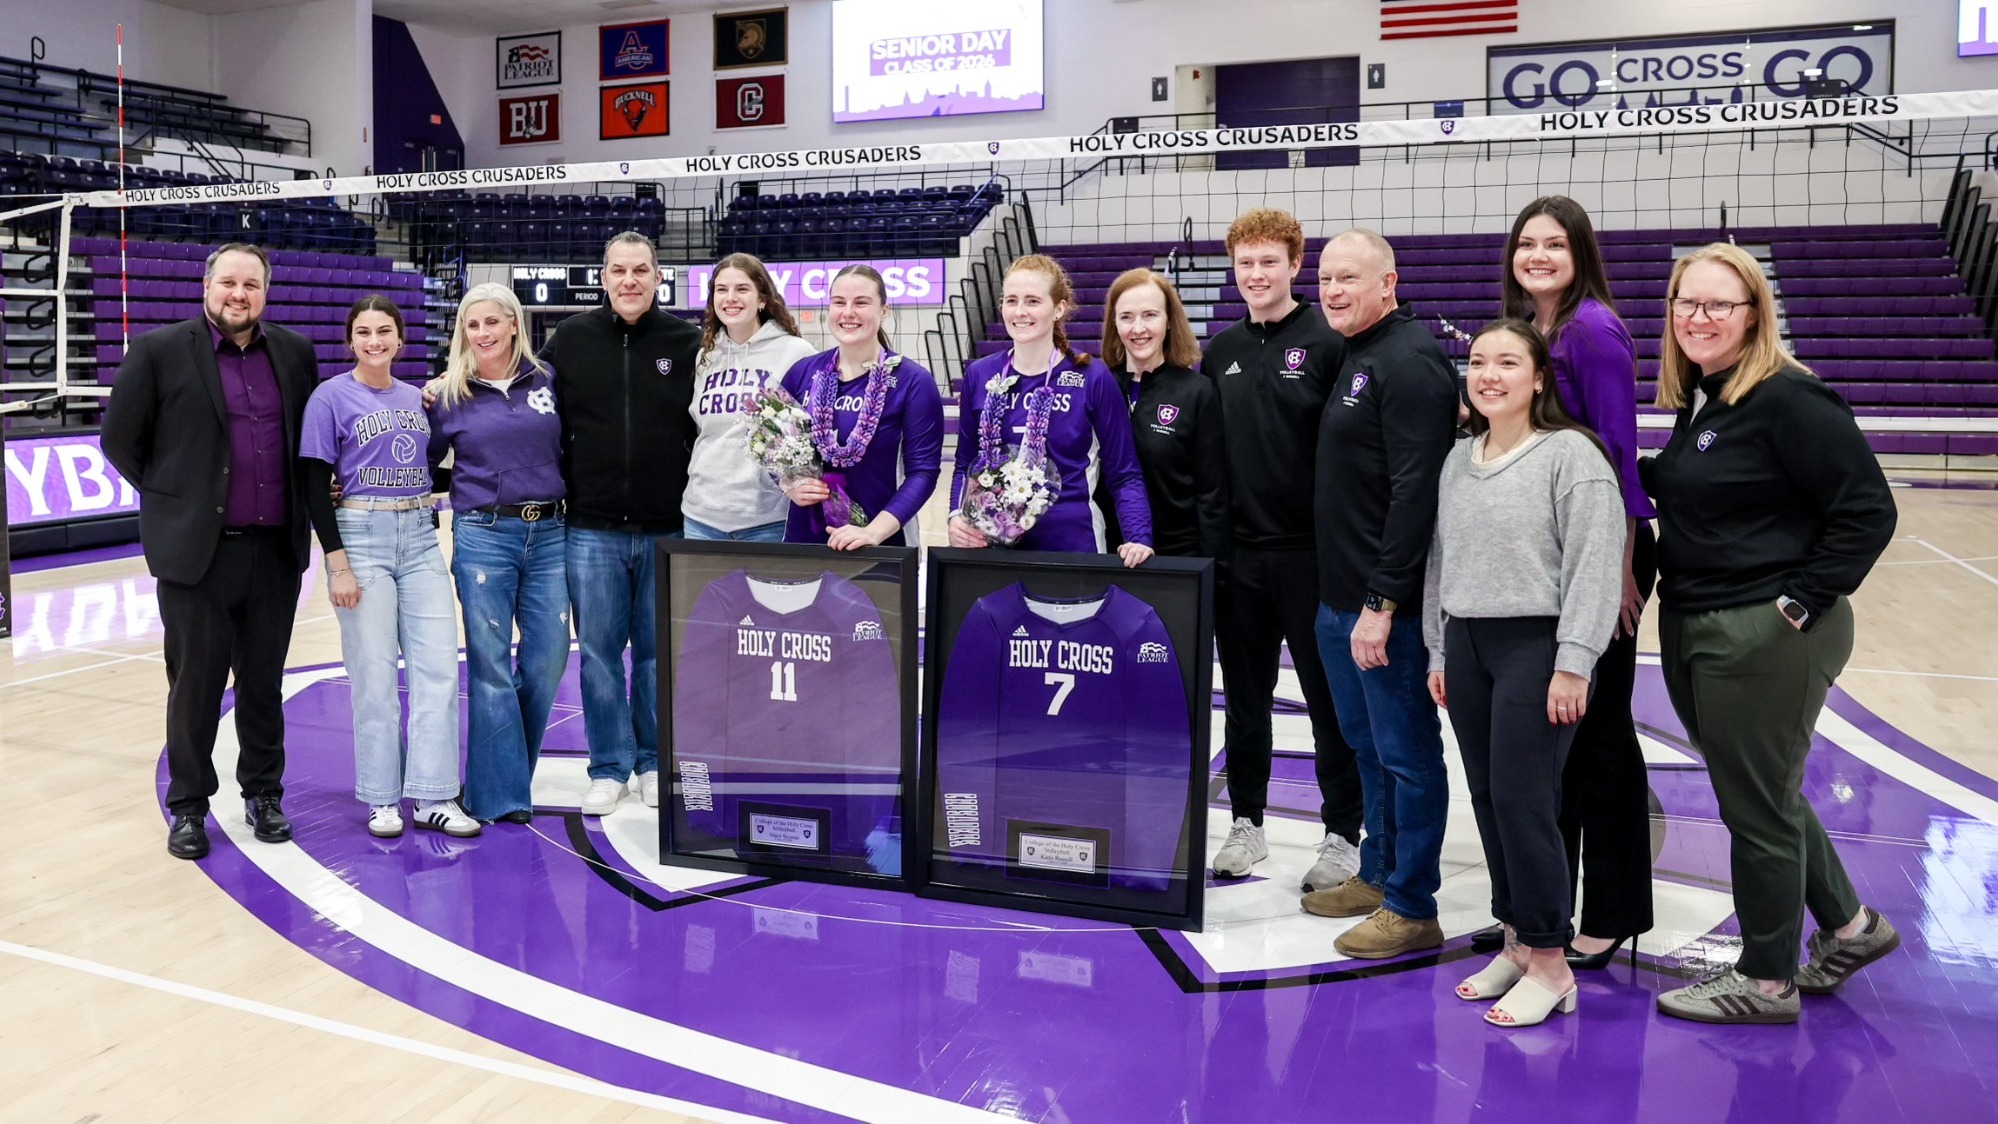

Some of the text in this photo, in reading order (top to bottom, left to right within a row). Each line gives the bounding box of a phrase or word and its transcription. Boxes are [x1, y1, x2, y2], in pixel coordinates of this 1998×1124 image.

[872, 30, 1008, 60] SENIOR DAY
[504, 59, 555, 71] PATRIOT
[504, 67, 554, 80] LEAGUE
[883, 53, 997, 75] CLASS OF 2026
[1764, 45, 1873, 98] GO
[1502, 52, 1743, 109] GO CROSS
[615, 90, 656, 109] BUCKNELL
[1541, 95, 1899, 131] HOLY CROSS CRUSADERS
[509, 100, 548, 138] BU
[1069, 123, 1358, 153] HOLY CROSS CRUSADERS
[686, 145, 922, 173] HOLY CROSS CRUSADERS
[376, 165, 567, 189] HOLY CROSS CRUSADERS
[126, 181, 281, 203] HOLY CROSS CRUSADERS
[242, 214, 251, 228] K
[535, 283, 548, 303] 0
[575, 292, 599, 300] PERIOD
[658, 283, 671, 303] 0
[801, 265, 931, 300] CSS
[702, 368, 772, 394] HOLY
[834, 395, 863, 412] CRO
[1023, 392, 1072, 413] CSS
[355, 409, 394, 448] HOLY
[737, 629, 832, 662] HOLY CROSS
[1009, 639, 1113, 674] HOLY CROSS
[770, 661, 797, 702] 11
[1044, 672, 1075, 716] 7
